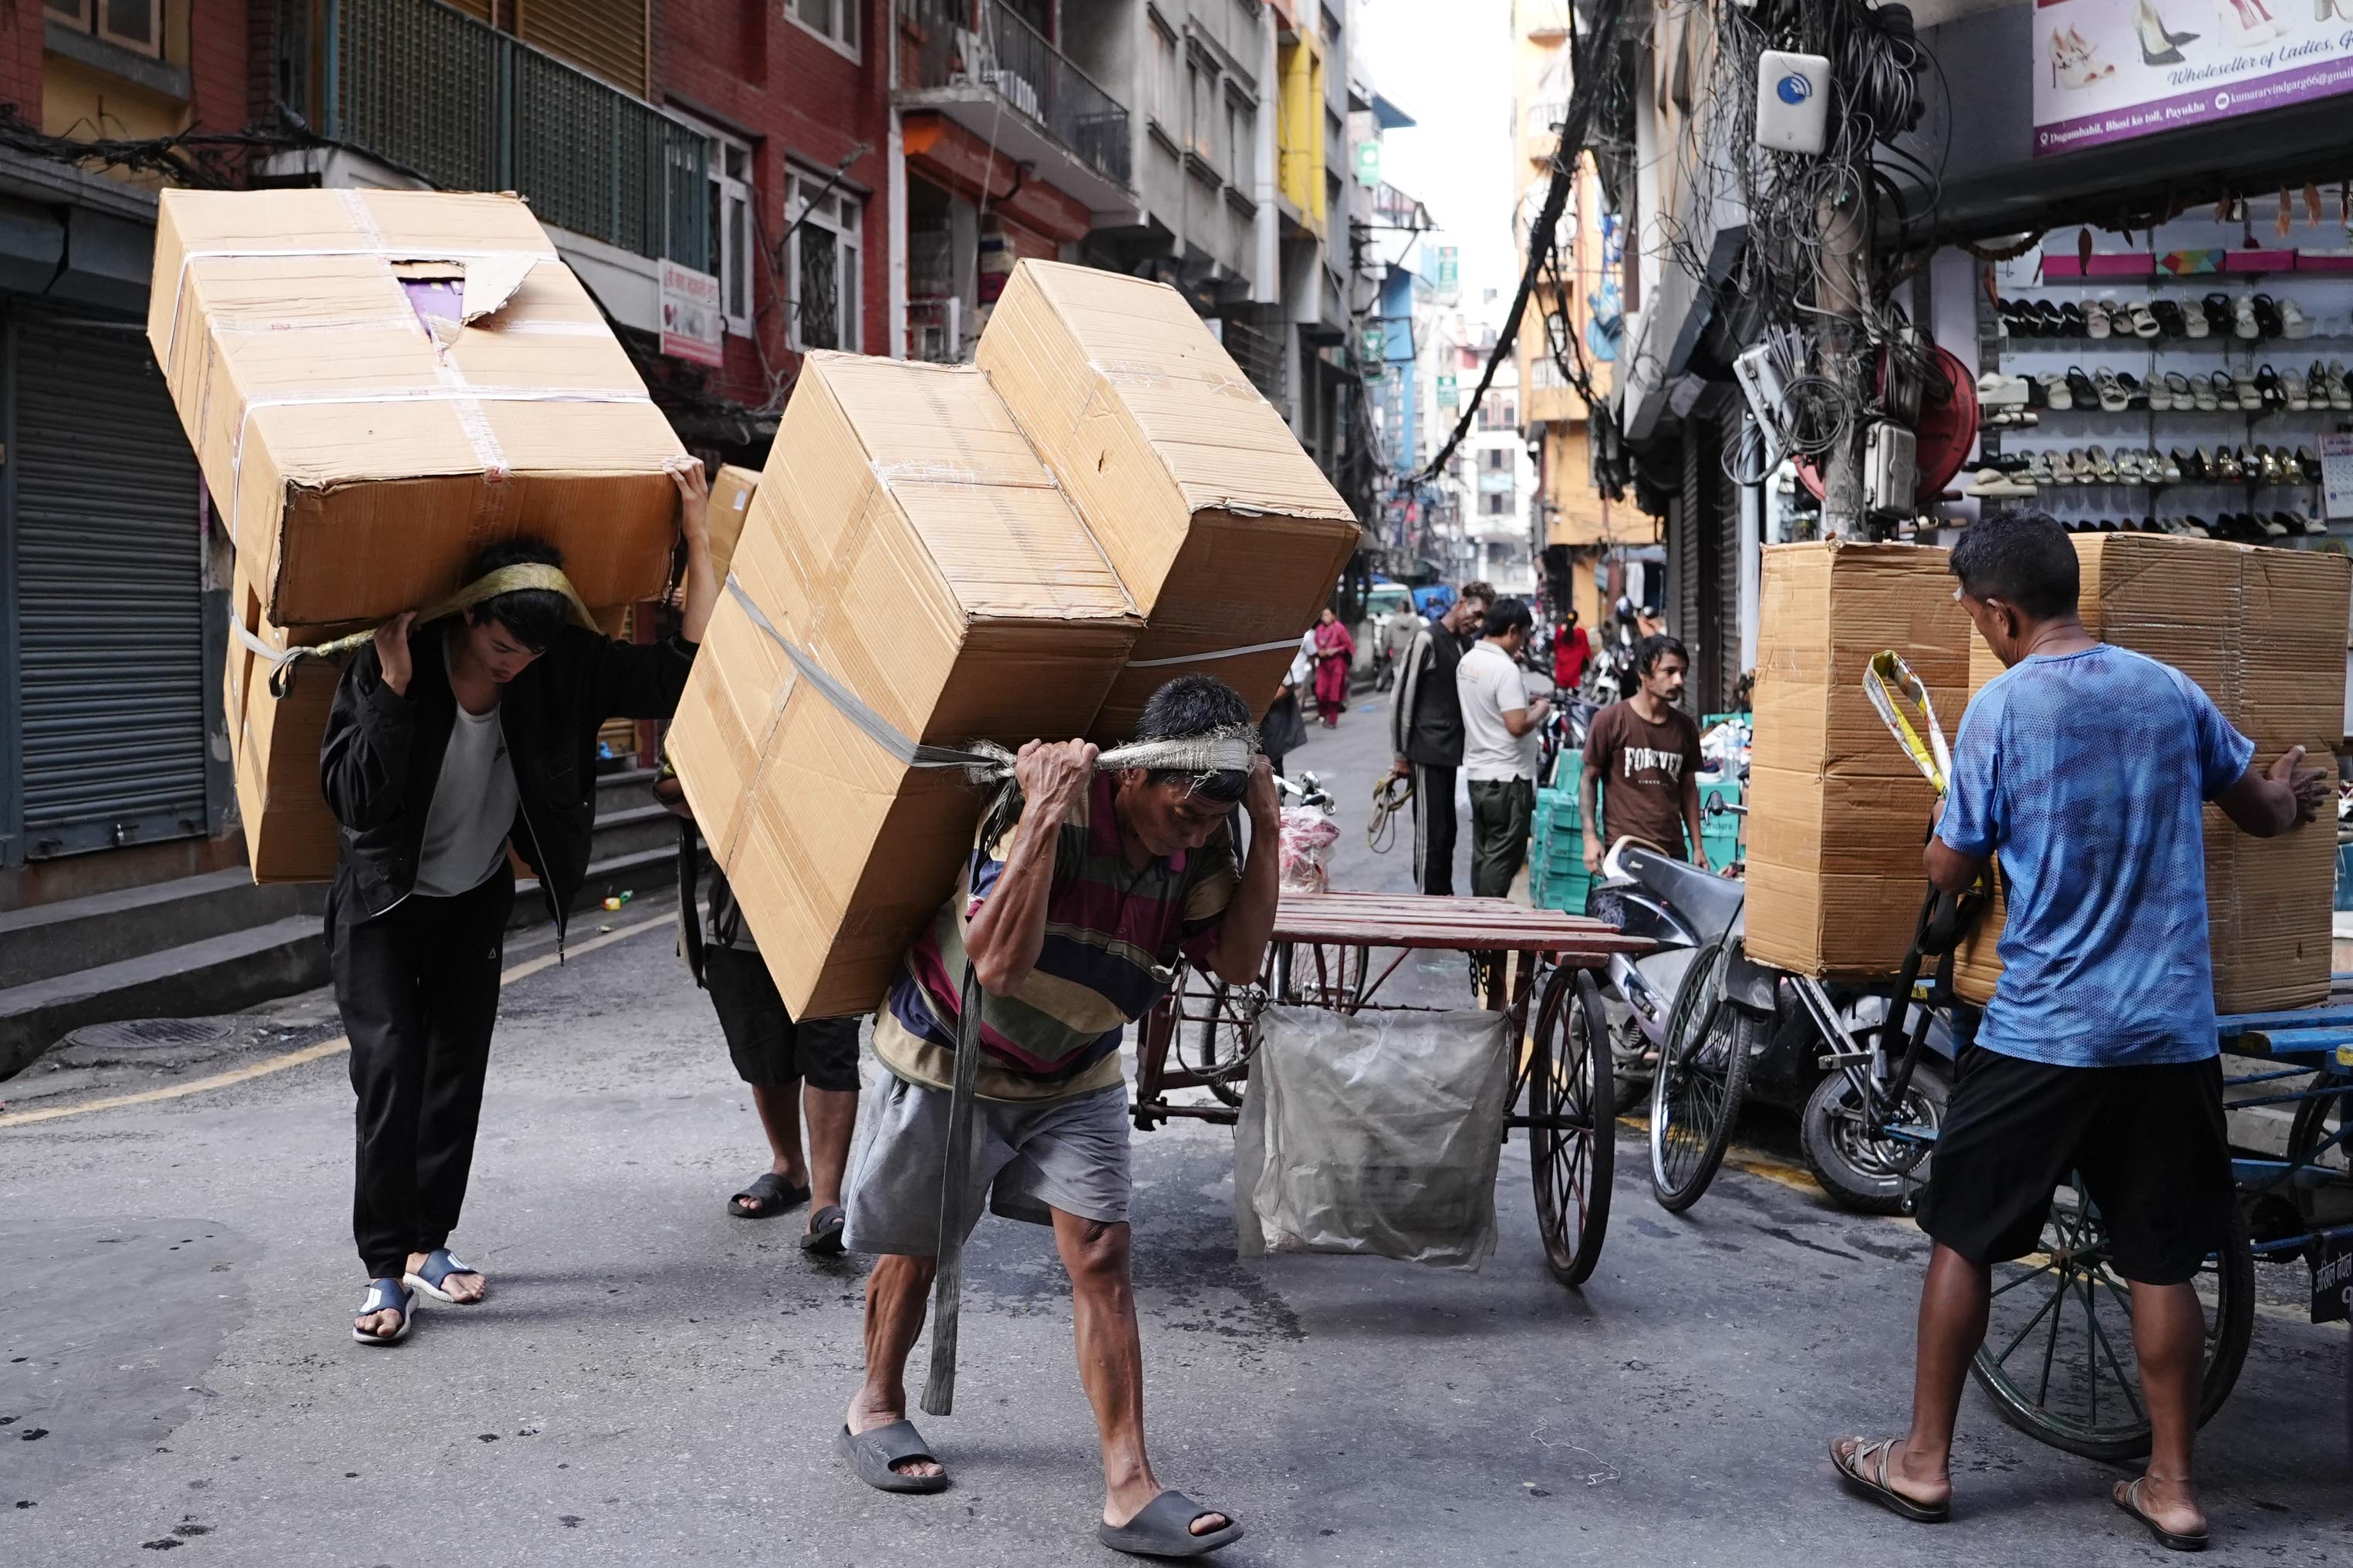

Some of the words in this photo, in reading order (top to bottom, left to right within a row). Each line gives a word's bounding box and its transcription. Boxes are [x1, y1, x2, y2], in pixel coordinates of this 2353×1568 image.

[2260, 52, 2274, 68] of
[2339, 31, 2353, 49] G
[2132, 116, 2143, 126] ko
